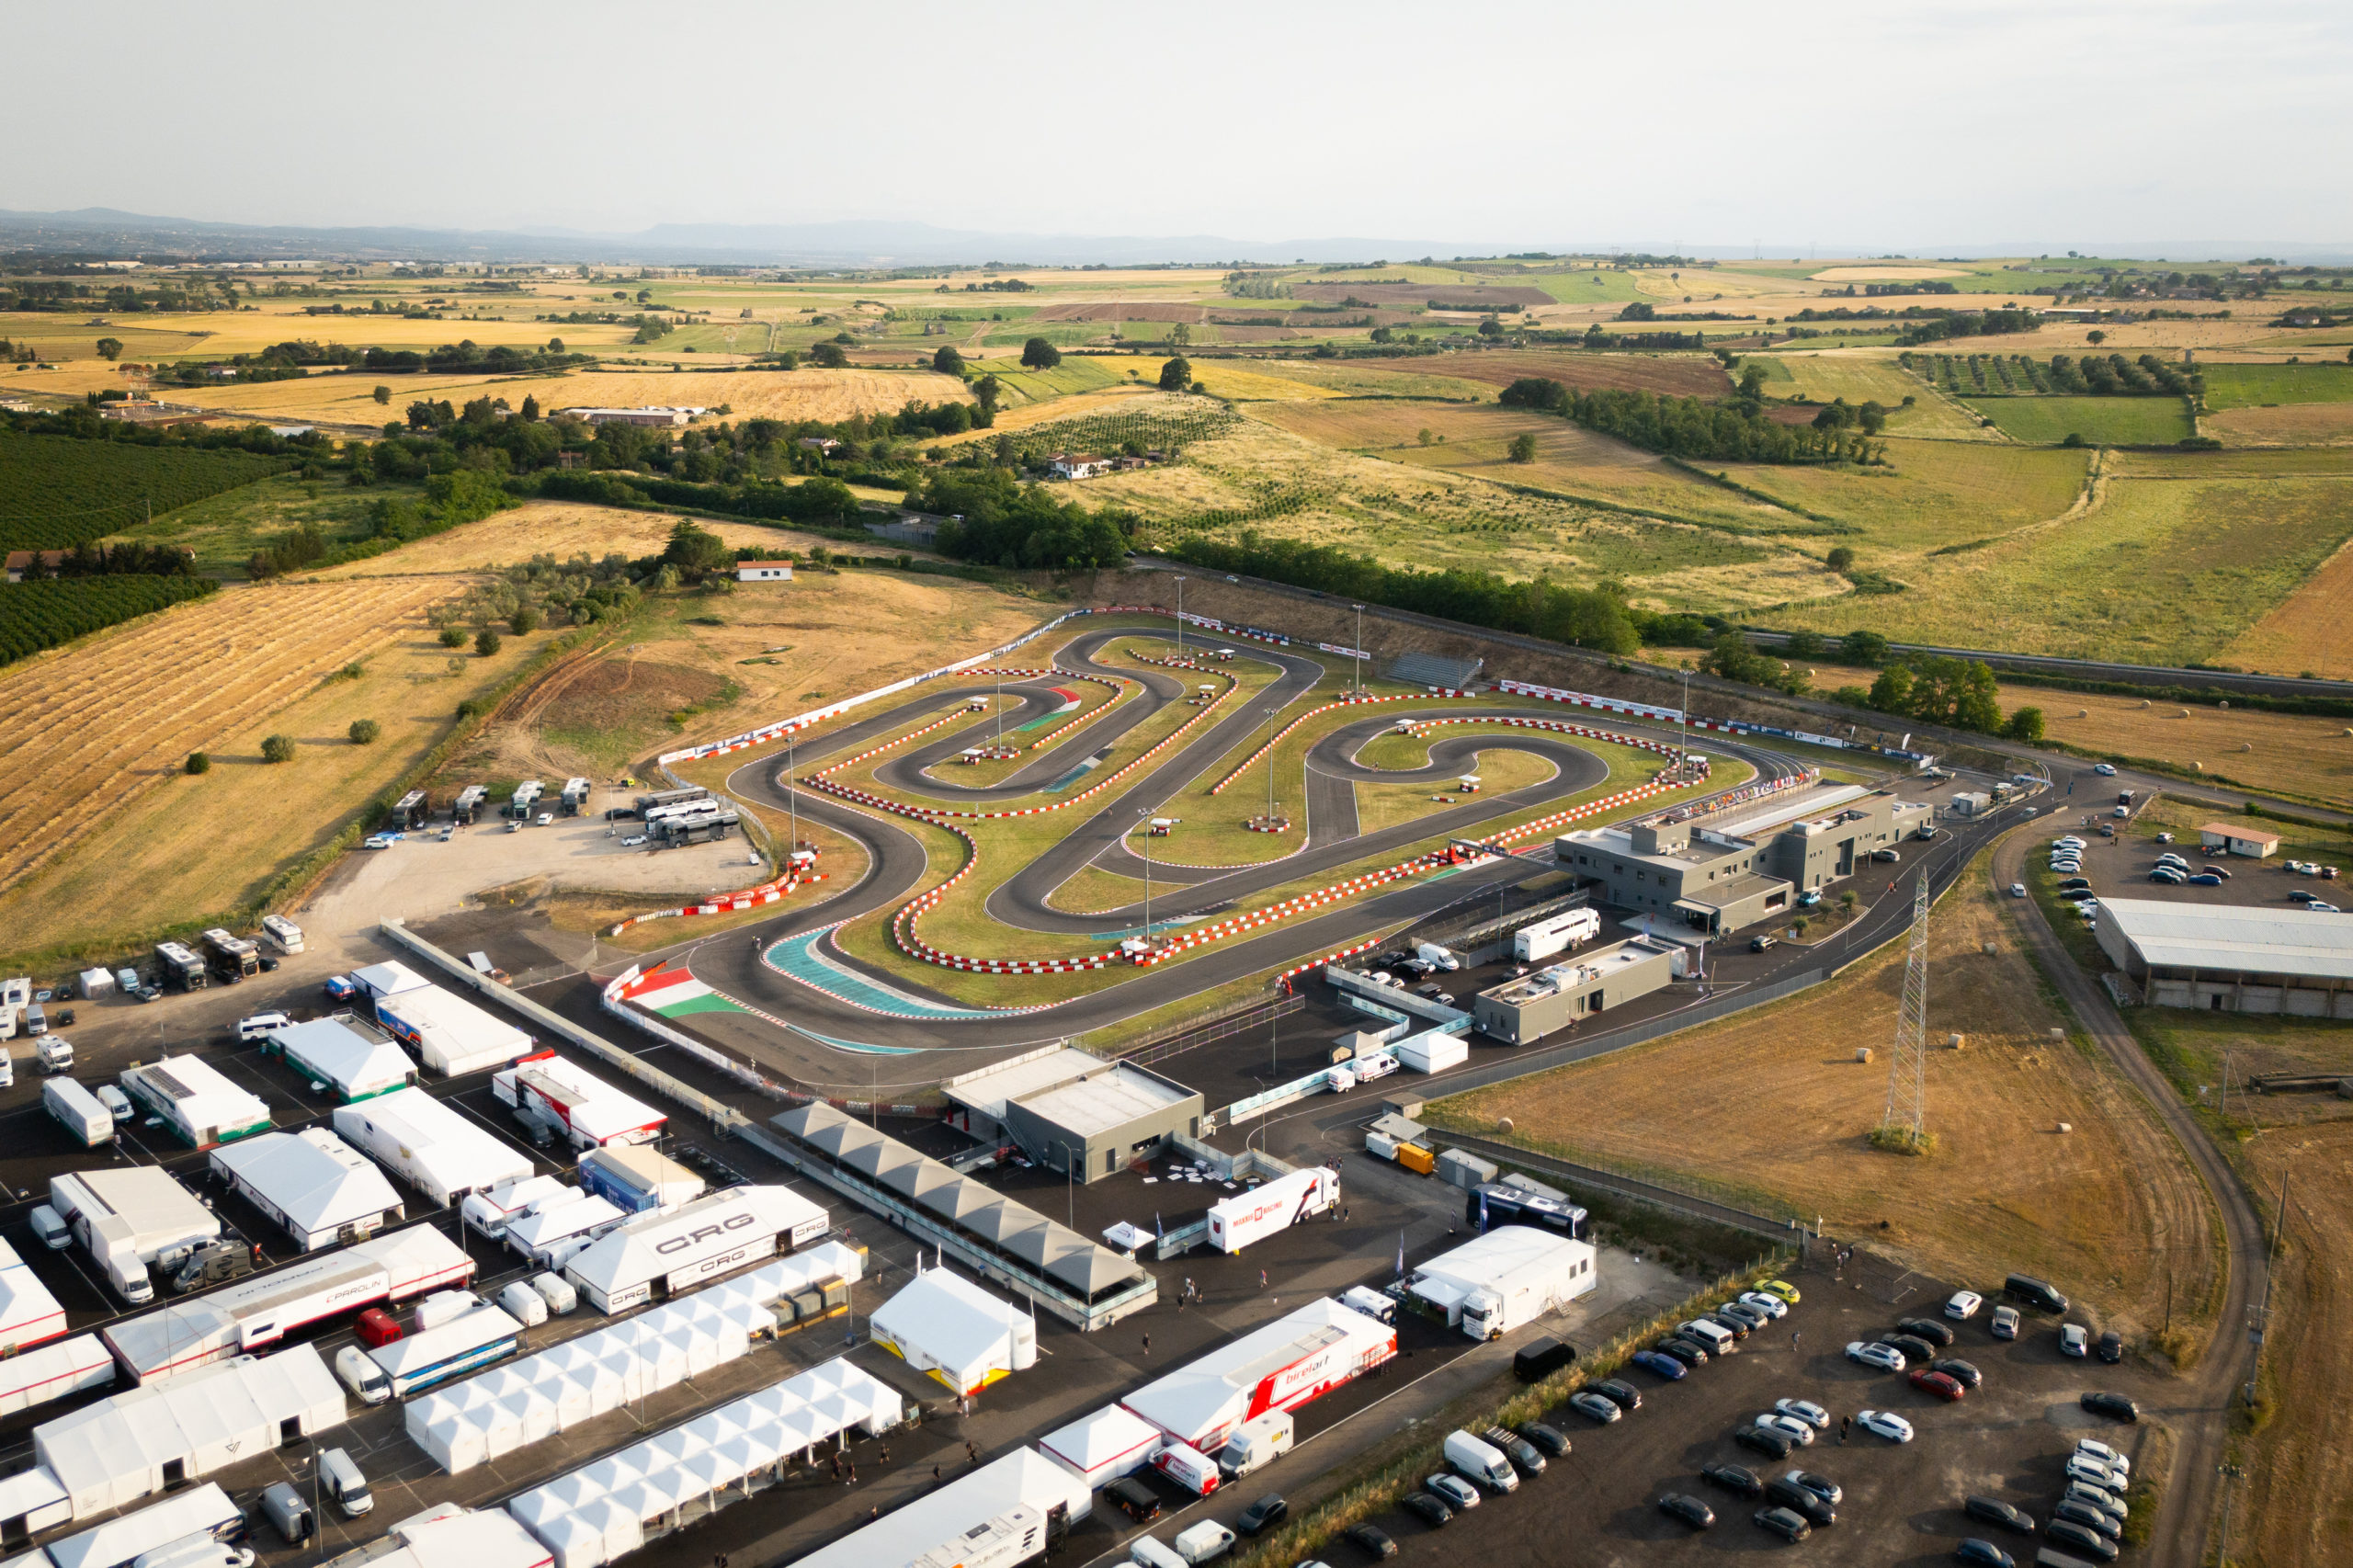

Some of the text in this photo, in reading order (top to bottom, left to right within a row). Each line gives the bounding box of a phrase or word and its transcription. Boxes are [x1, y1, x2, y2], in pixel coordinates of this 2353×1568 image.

[1233, 1200, 1283, 1228] MAXXIS RACING
[655, 1213, 756, 1255] CRG
[794, 1221, 826, 1237] CRG
[700, 1250, 745, 1273] CRG
[334, 1279, 381, 1301] PAROLIN
[611, 1288, 647, 1305] CRG
[1286, 1355, 1330, 1384] birelart
